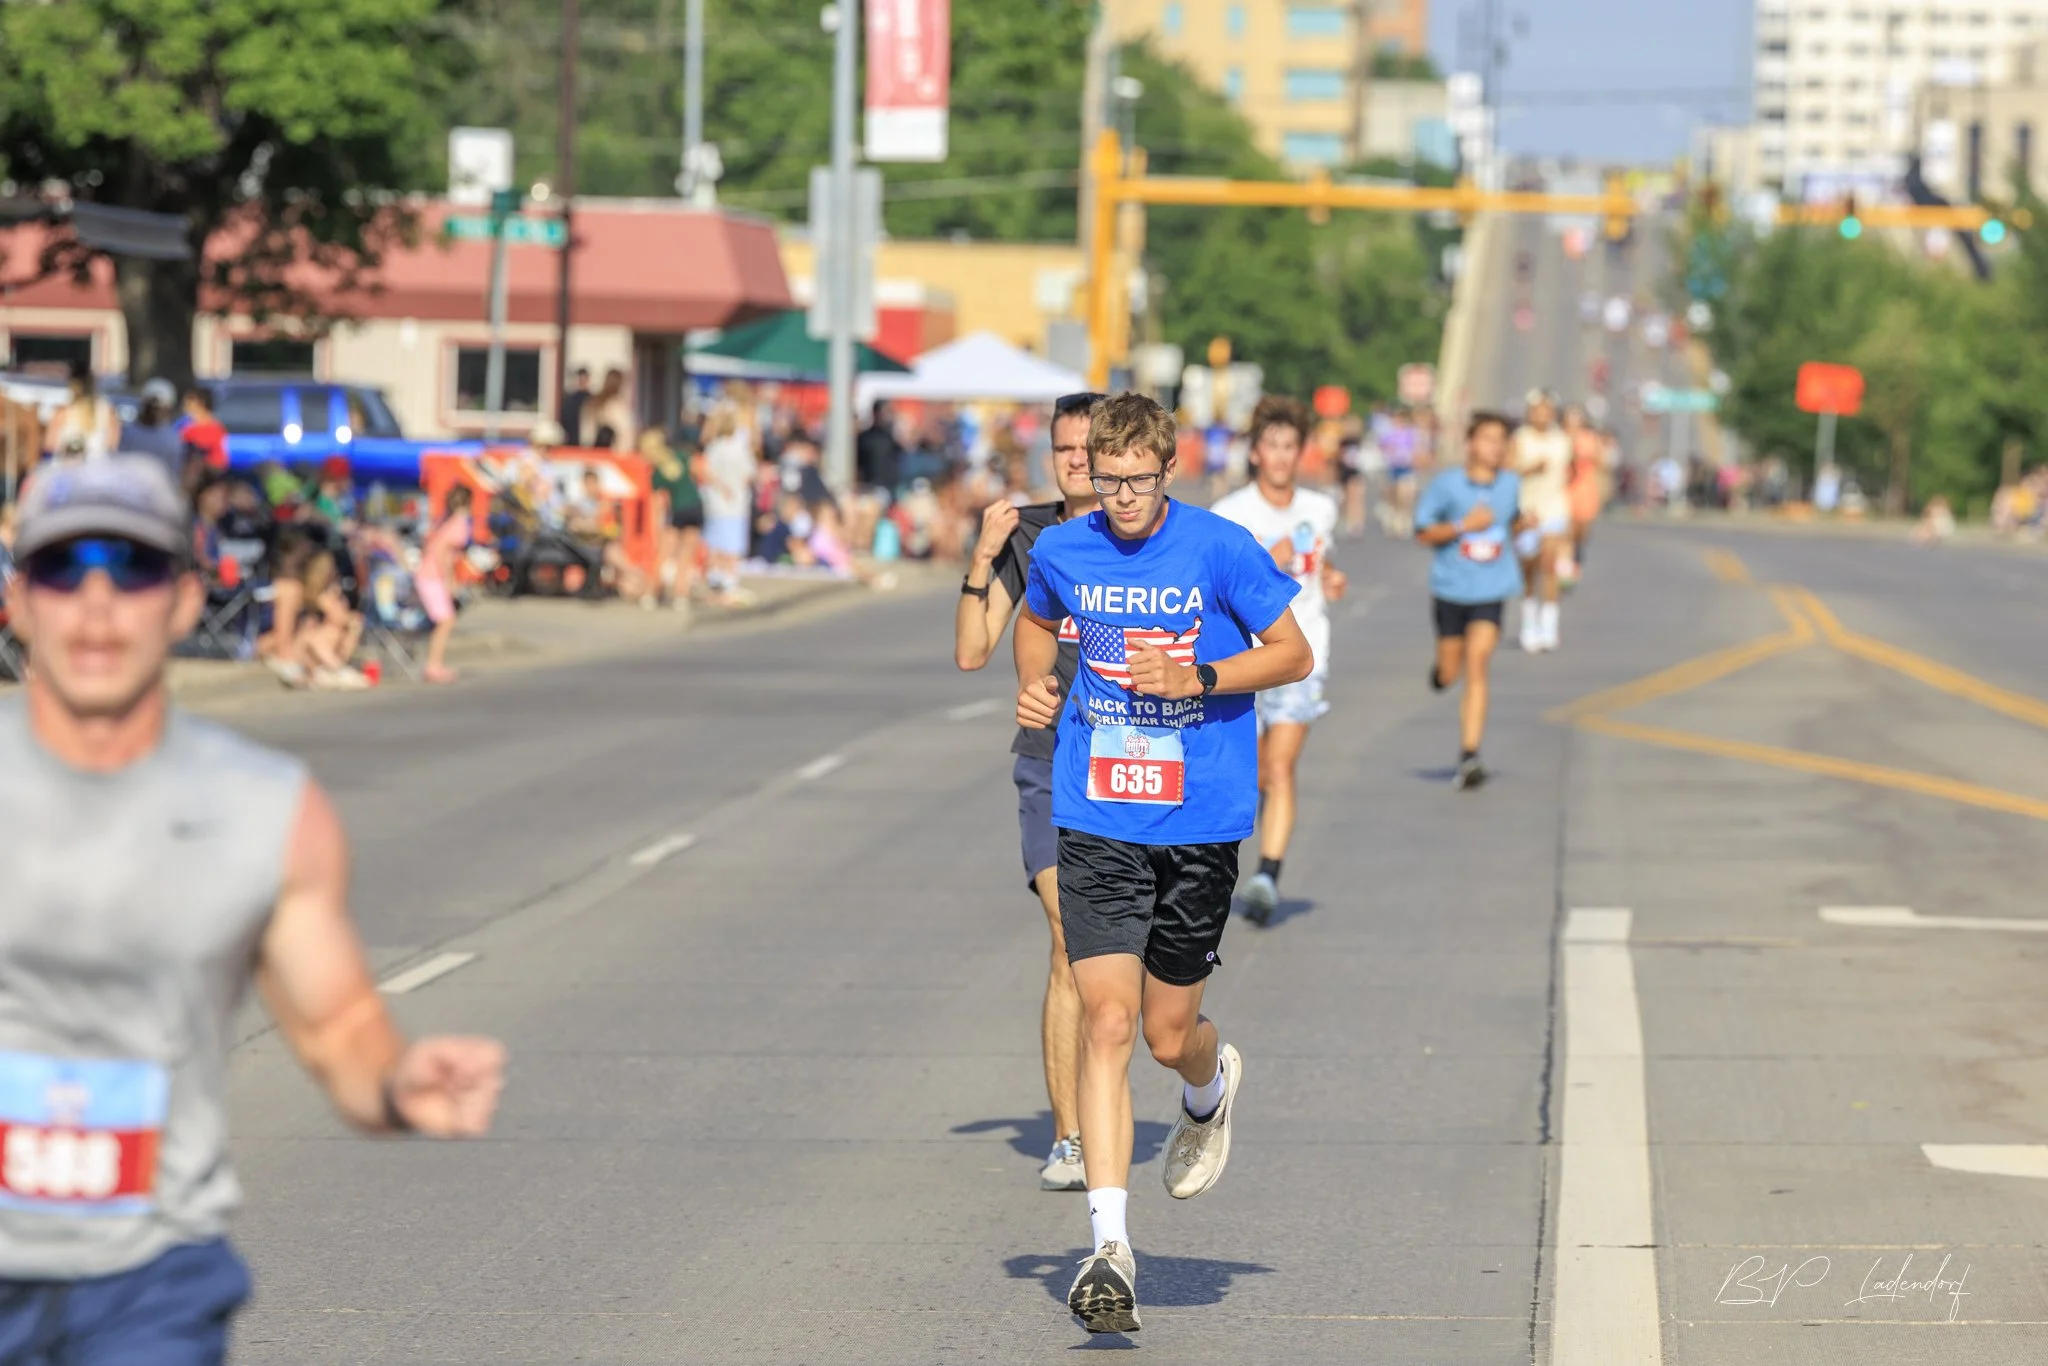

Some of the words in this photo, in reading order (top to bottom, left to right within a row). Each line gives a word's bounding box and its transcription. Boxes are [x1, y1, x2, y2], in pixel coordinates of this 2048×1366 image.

[1074, 584, 1204, 615] 'MERICA
[1088, 695, 1128, 715] BACK
[1132, 701, 1157, 715] TO
[1162, 696, 1205, 716] BACK
[1088, 709, 1126, 725] WORLD
[1129, 716, 1159, 726] WAR
[1111, 763, 1163, 795] 635
